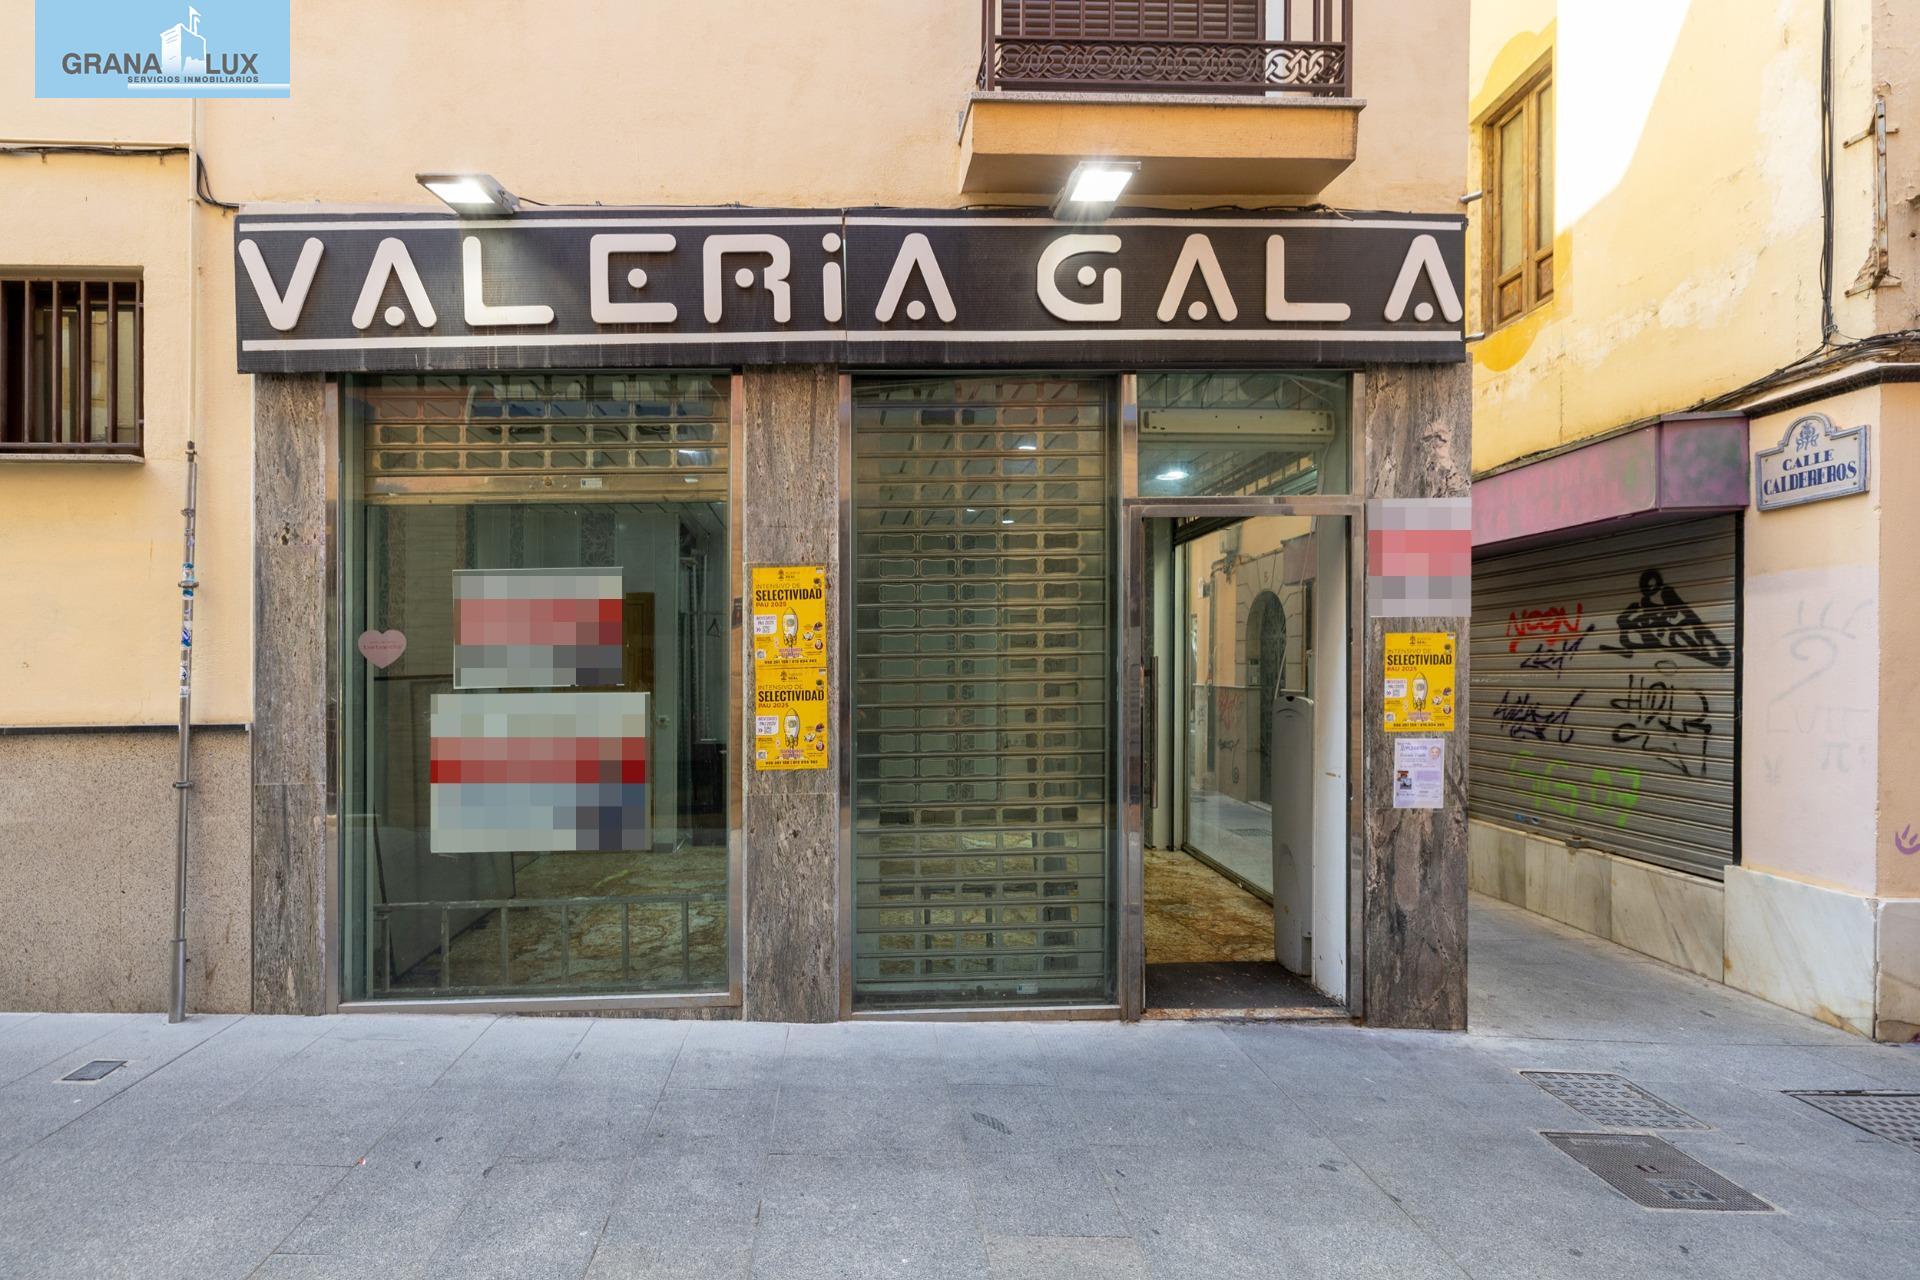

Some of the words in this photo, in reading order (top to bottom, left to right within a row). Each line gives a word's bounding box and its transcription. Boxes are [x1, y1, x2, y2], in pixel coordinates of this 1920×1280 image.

[1037, 233, 1463, 322] GALA
[1782, 449, 1834, 471] CALLE
[1763, 460, 1857, 495] CALDEREROS
[756, 588, 822, 601] SELECTIVIDAD
[1387, 654, 1452, 665] SELECTIVIDAD
[758, 690, 824, 702] SELECTIVIDAD
